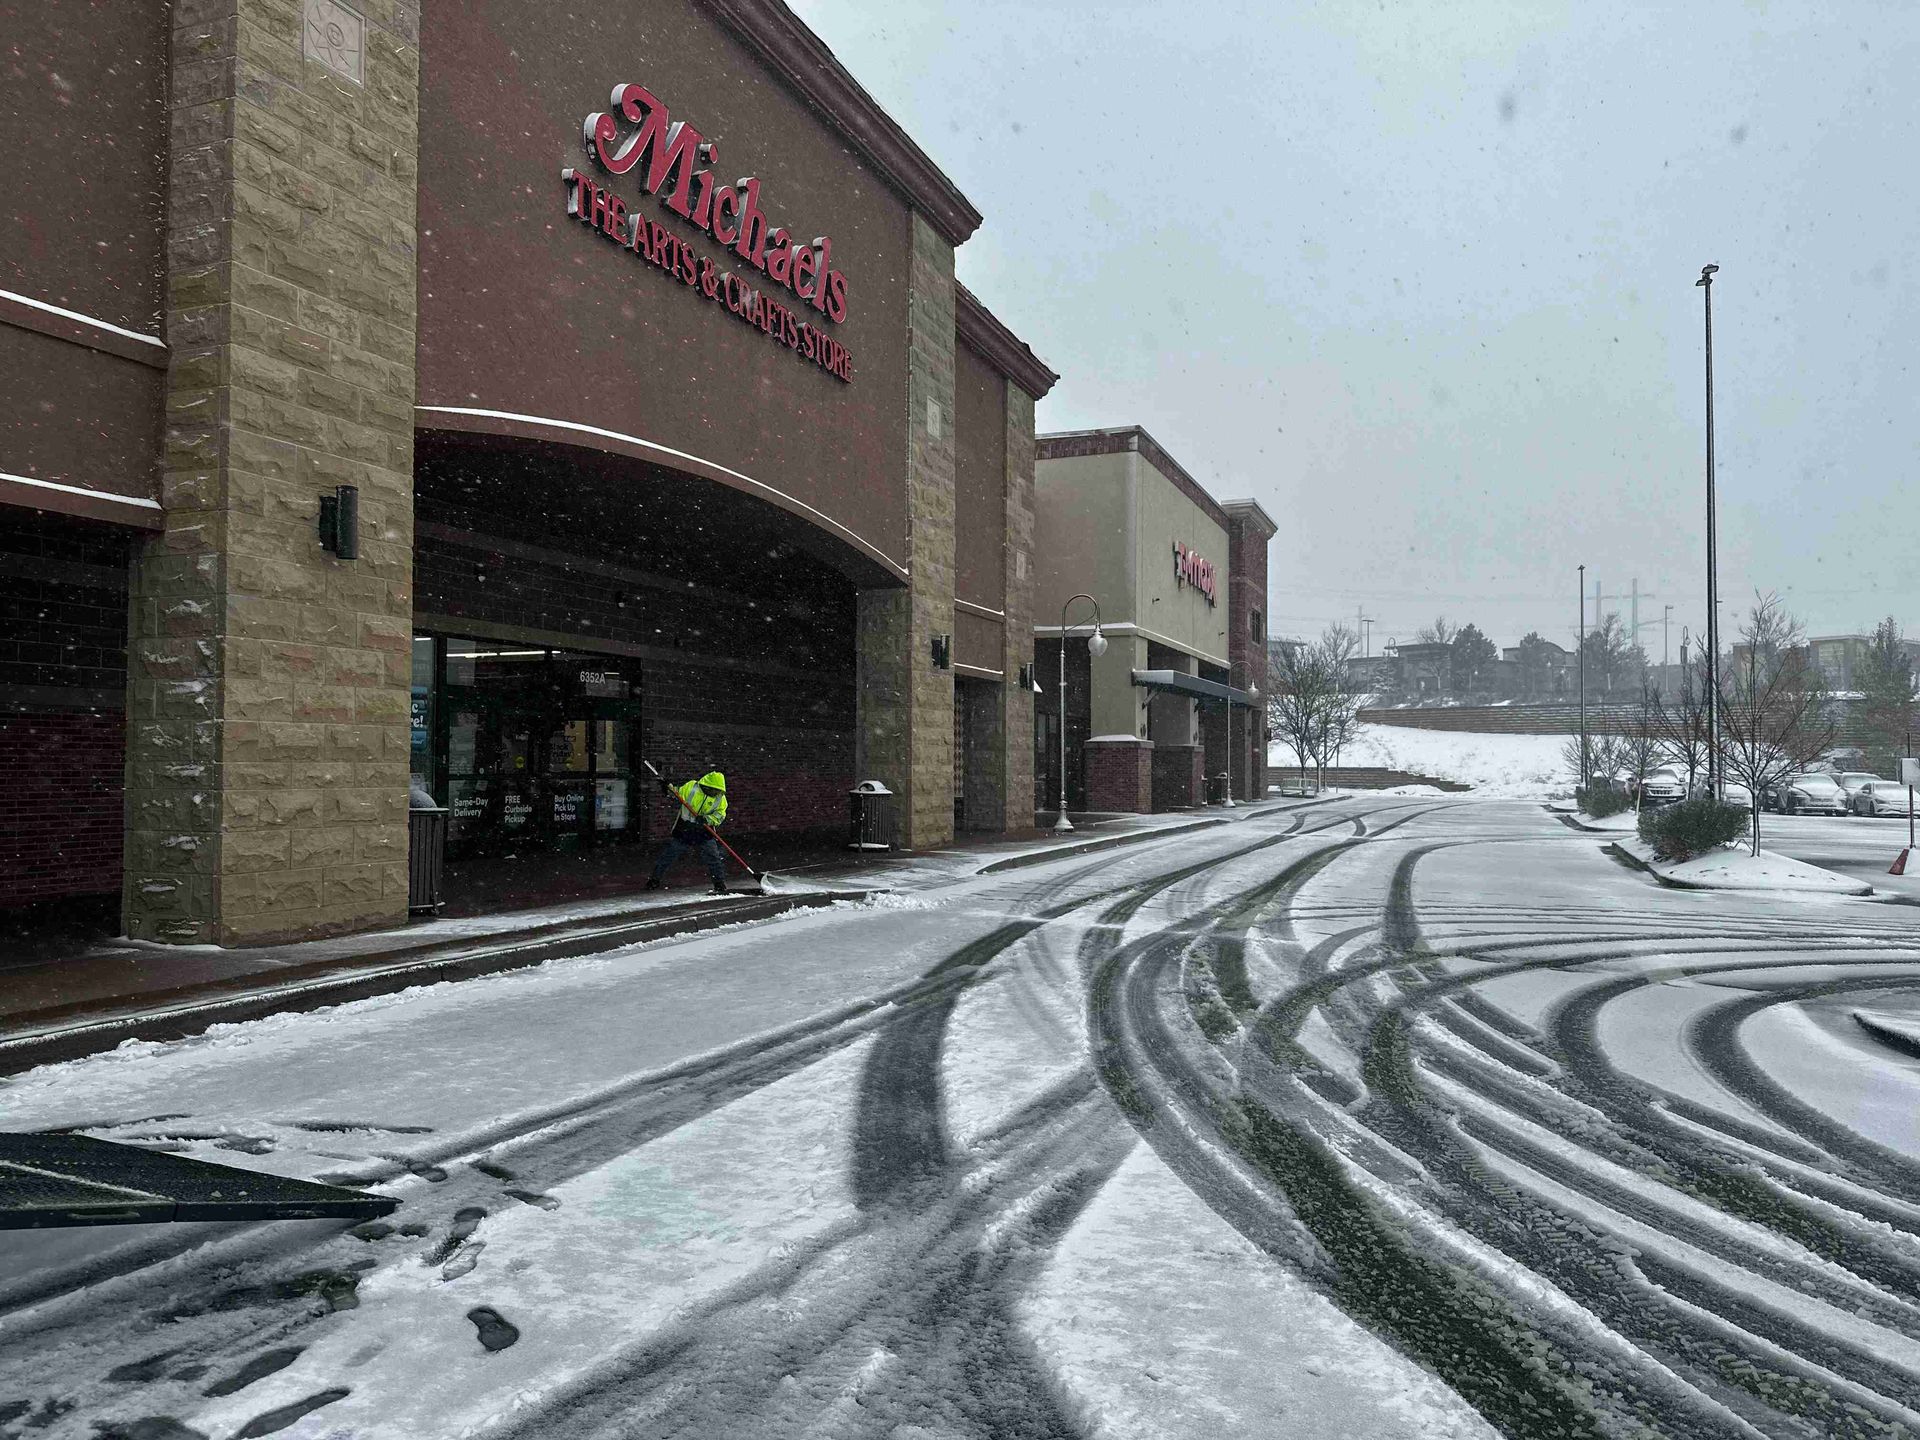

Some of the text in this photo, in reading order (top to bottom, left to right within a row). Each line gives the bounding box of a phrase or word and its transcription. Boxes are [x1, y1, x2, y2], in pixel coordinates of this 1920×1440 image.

[584, 83, 848, 324] Michaels
[562, 168, 853, 384] THE ARTS & CRAFTS STORE
[580, 671, 606, 684] 6352A
[454, 797, 488, 807] Same-Day
[505, 795, 521, 804] FREE
[555, 794, 585, 803] Buy Online
[454, 808, 482, 818] Delivery
[504, 805, 533, 813] Curbside
[555, 803, 576, 813] Pick Up
[504, 815, 526, 824] Pickup
[560, 812, 576, 821] Store
